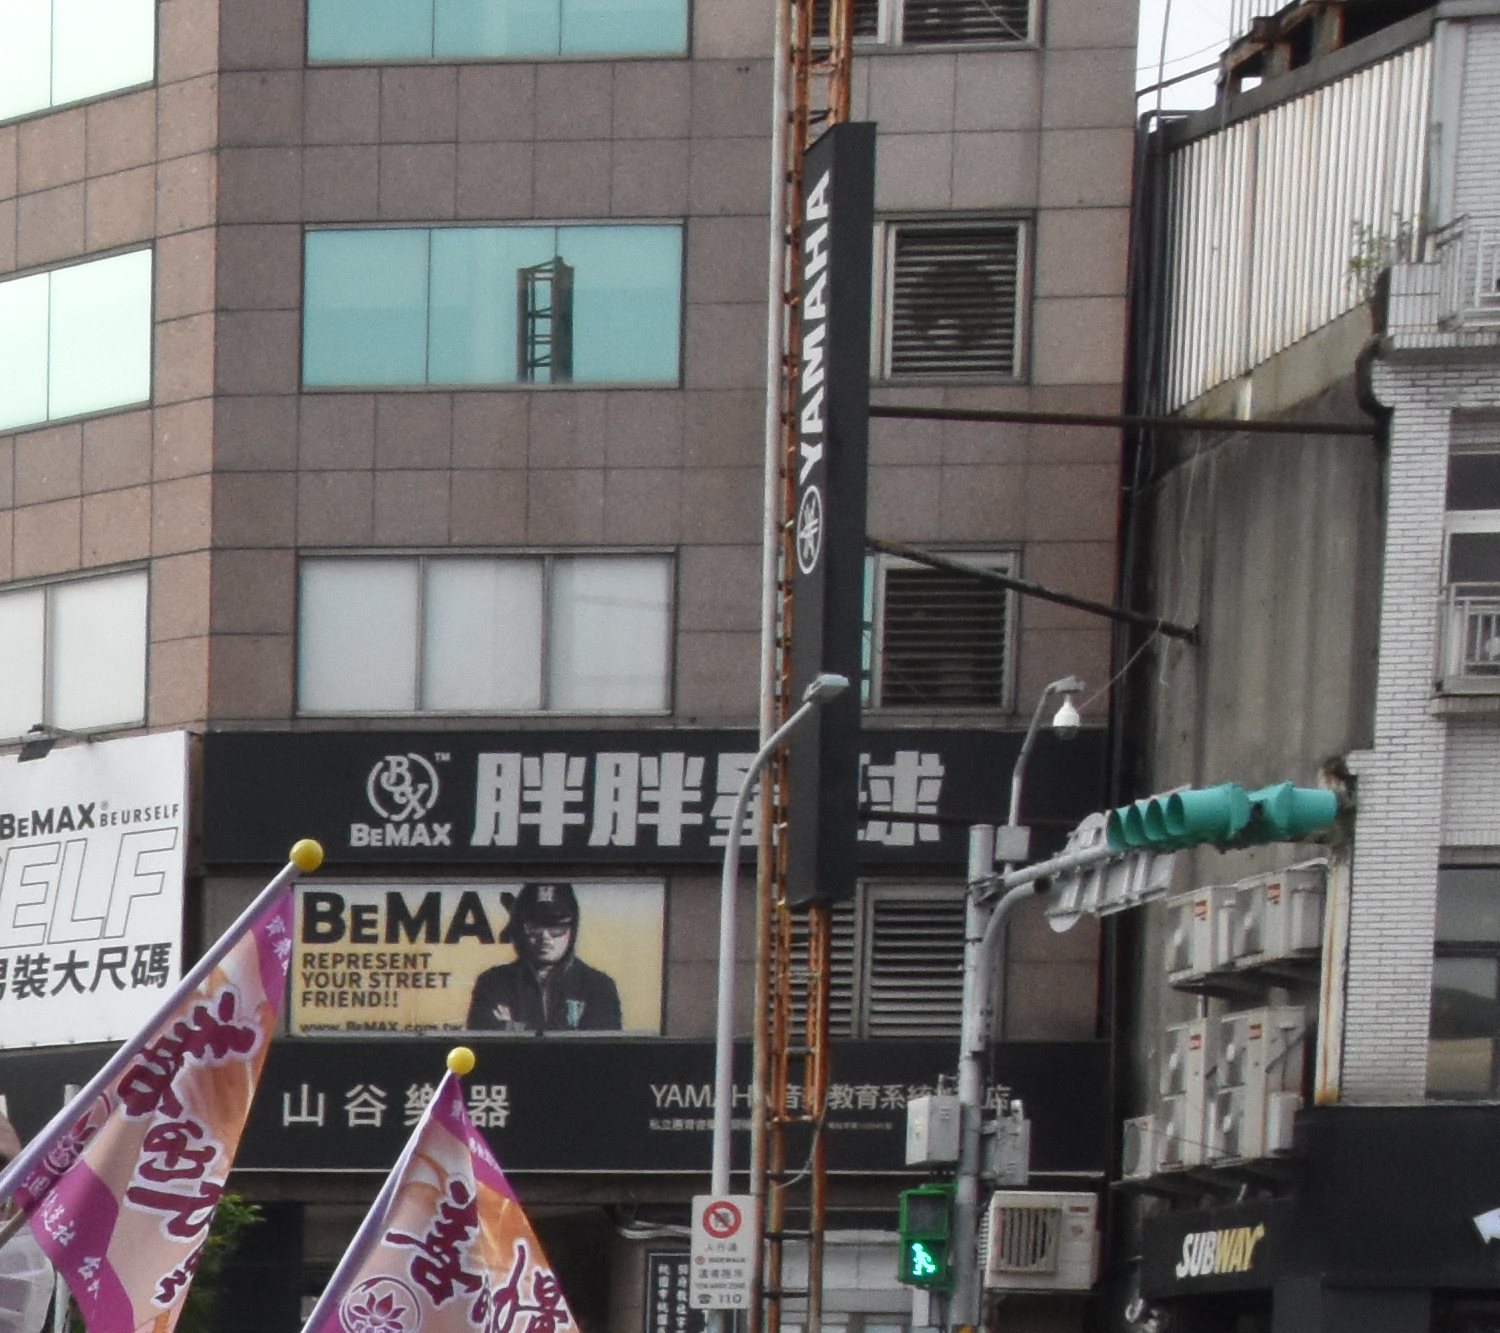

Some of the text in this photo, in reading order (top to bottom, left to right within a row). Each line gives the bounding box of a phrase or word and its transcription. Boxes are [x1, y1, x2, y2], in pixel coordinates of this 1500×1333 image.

[799, 170, 830, 485] YAMAHA
[301, 952, 433, 970] REPRESENT
[301, 971, 452, 989] YOUR STREET
[301, 990, 400, 1008] FRIEND!!
[282, 1082, 511, 1129] 山谷樂器
[1175, 1224, 1265, 1281] SUBWAY
